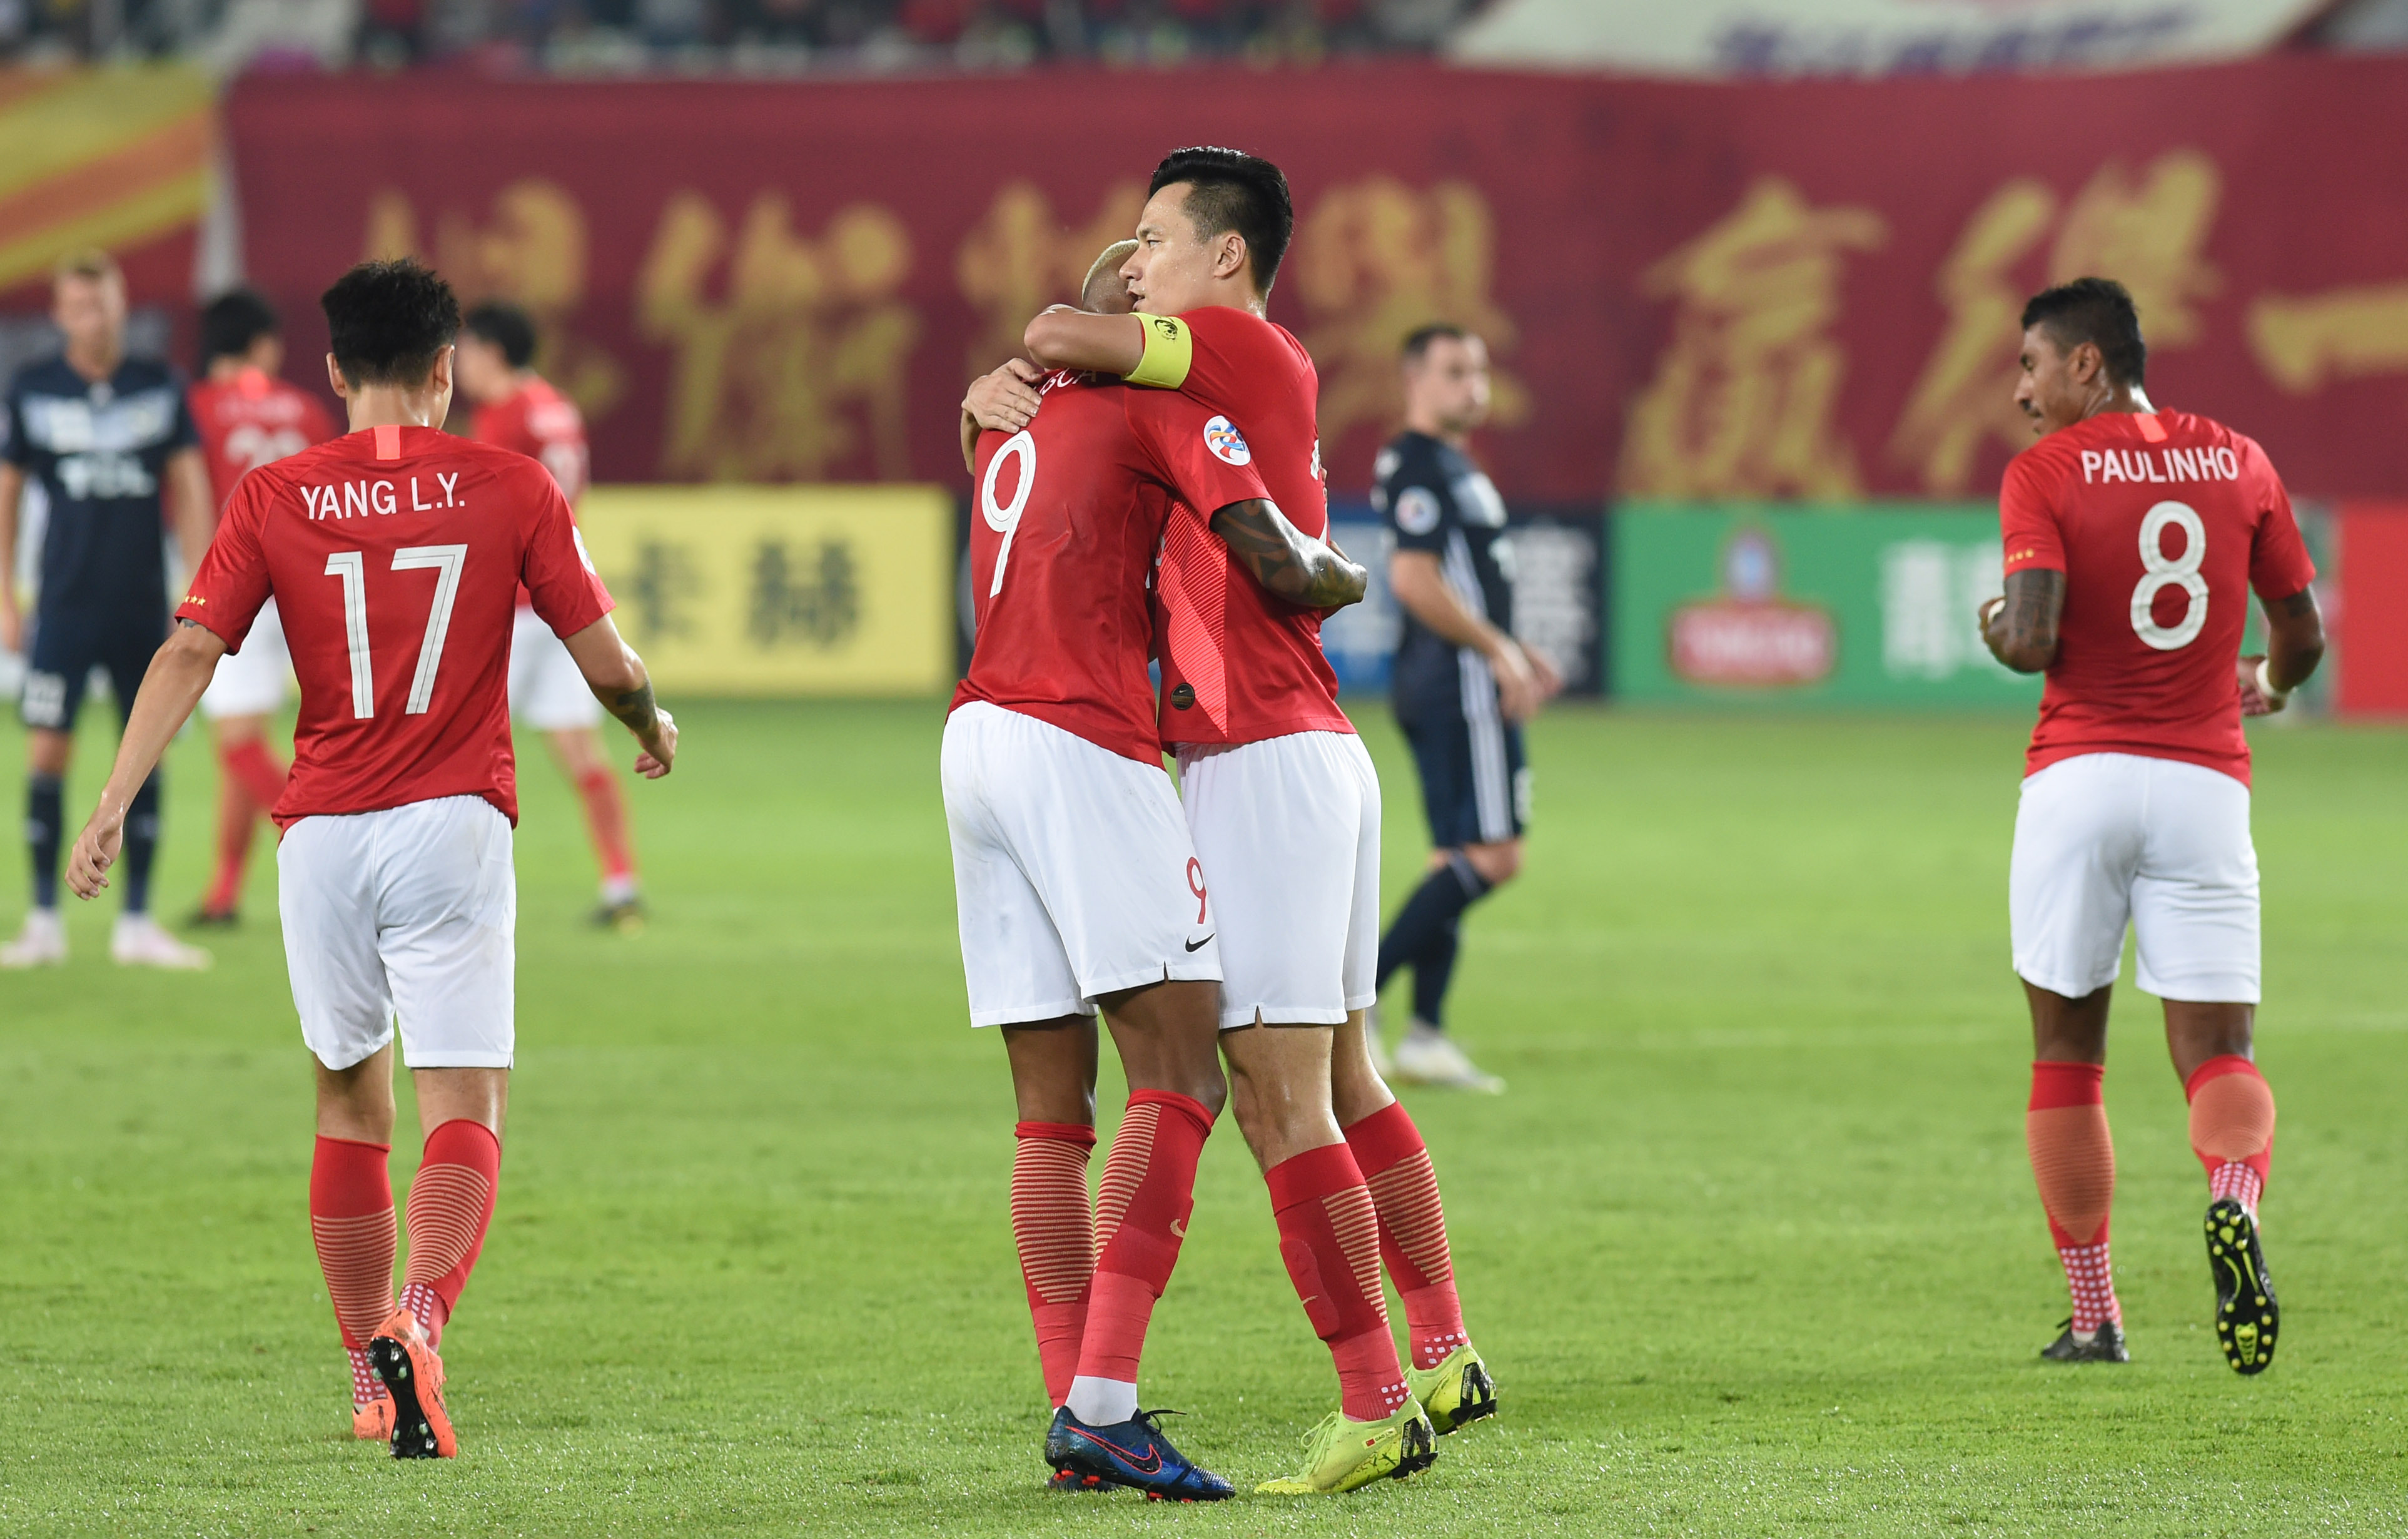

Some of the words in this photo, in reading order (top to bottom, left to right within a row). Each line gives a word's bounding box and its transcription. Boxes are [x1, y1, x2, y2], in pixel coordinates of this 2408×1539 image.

[300, 479, 397, 521] YANG
[411, 472, 465, 512] L.Y.
[981, 430, 1036, 599] 9
[2081, 445, 2239, 484] PAULINHO
[2130, 500, 2209, 651] 8
[324, 543, 468, 719] 17
[1186, 856, 1207, 925] 9
